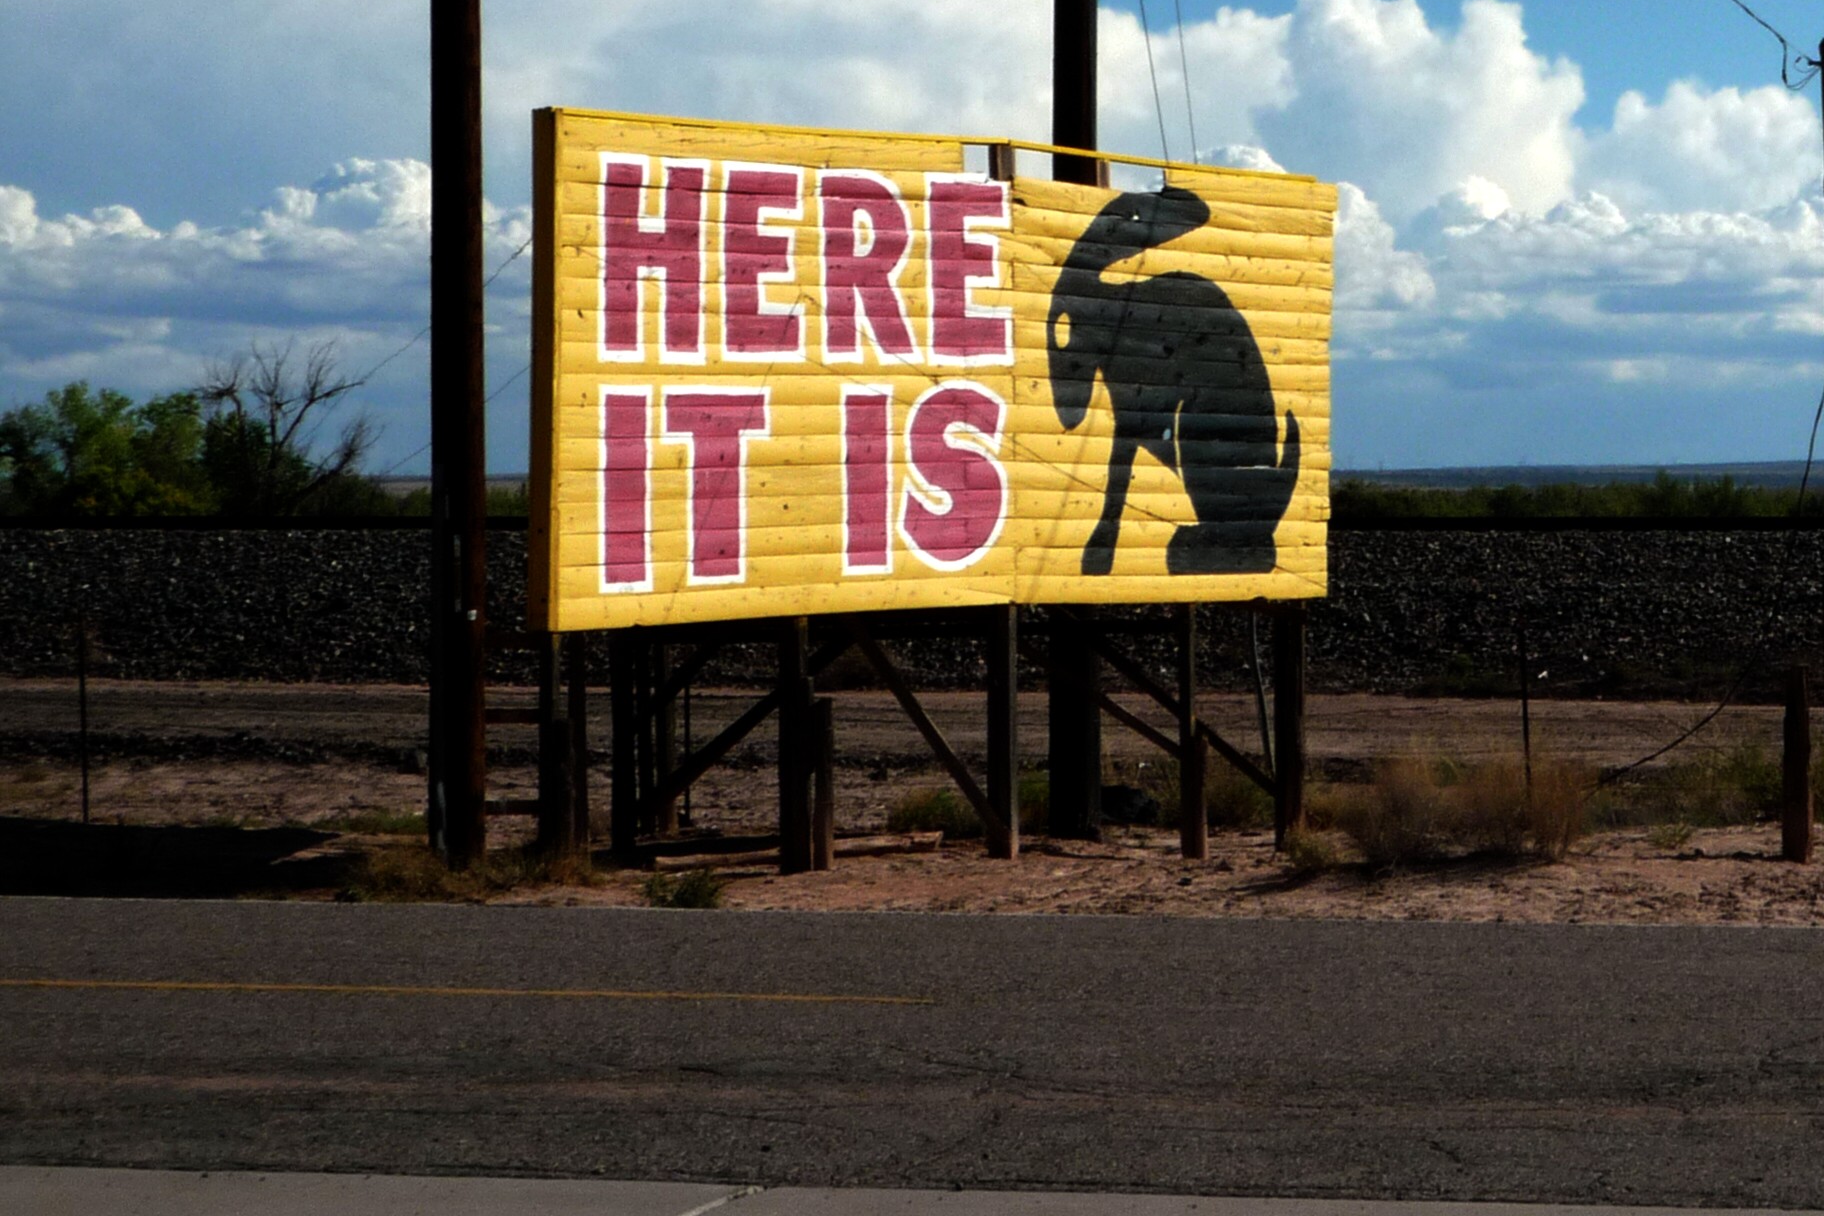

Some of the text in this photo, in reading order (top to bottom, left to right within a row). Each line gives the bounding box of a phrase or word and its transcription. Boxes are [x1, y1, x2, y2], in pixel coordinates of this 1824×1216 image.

[601, 153, 1013, 366] HERE
[601, 380, 1006, 592] IT IS
